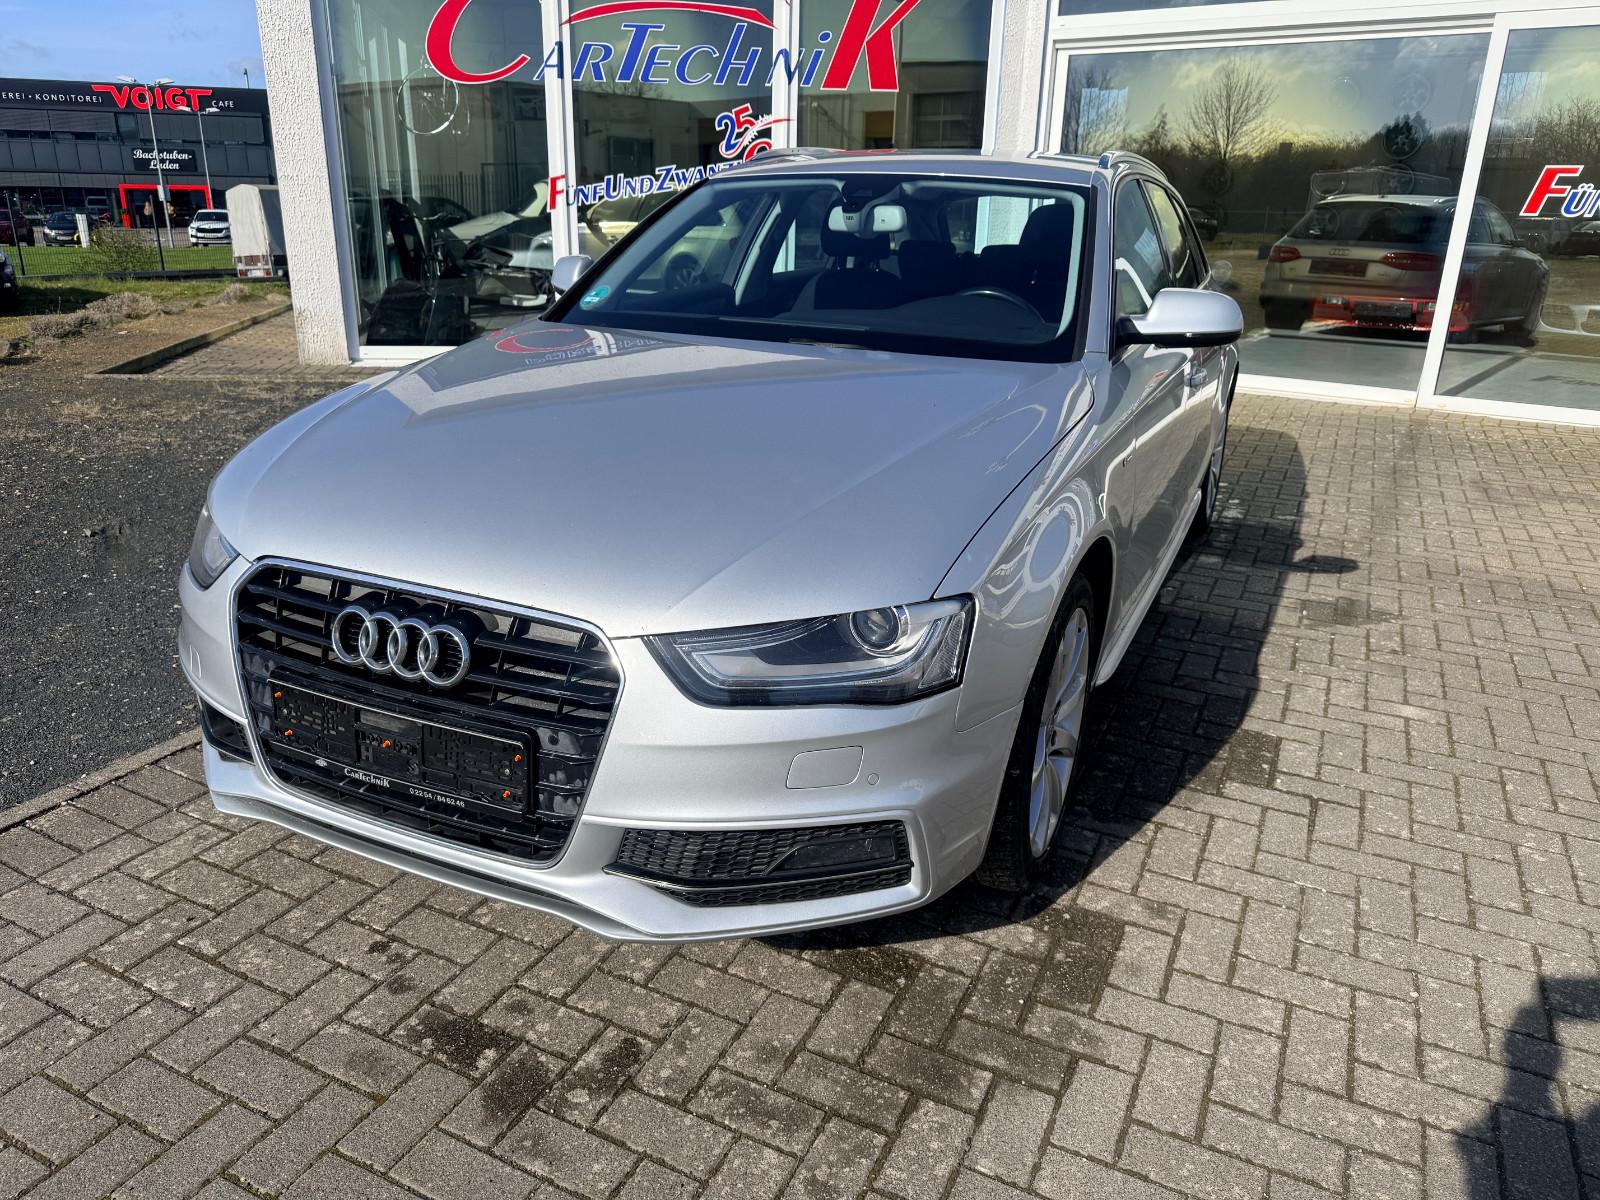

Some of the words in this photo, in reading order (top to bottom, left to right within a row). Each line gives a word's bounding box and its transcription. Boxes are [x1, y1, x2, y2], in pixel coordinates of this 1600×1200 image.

[35, 93, 102, 103] KONDITOREI
[91, 84, 213, 112] VOIGT
[715, 103, 758, 157] 25
